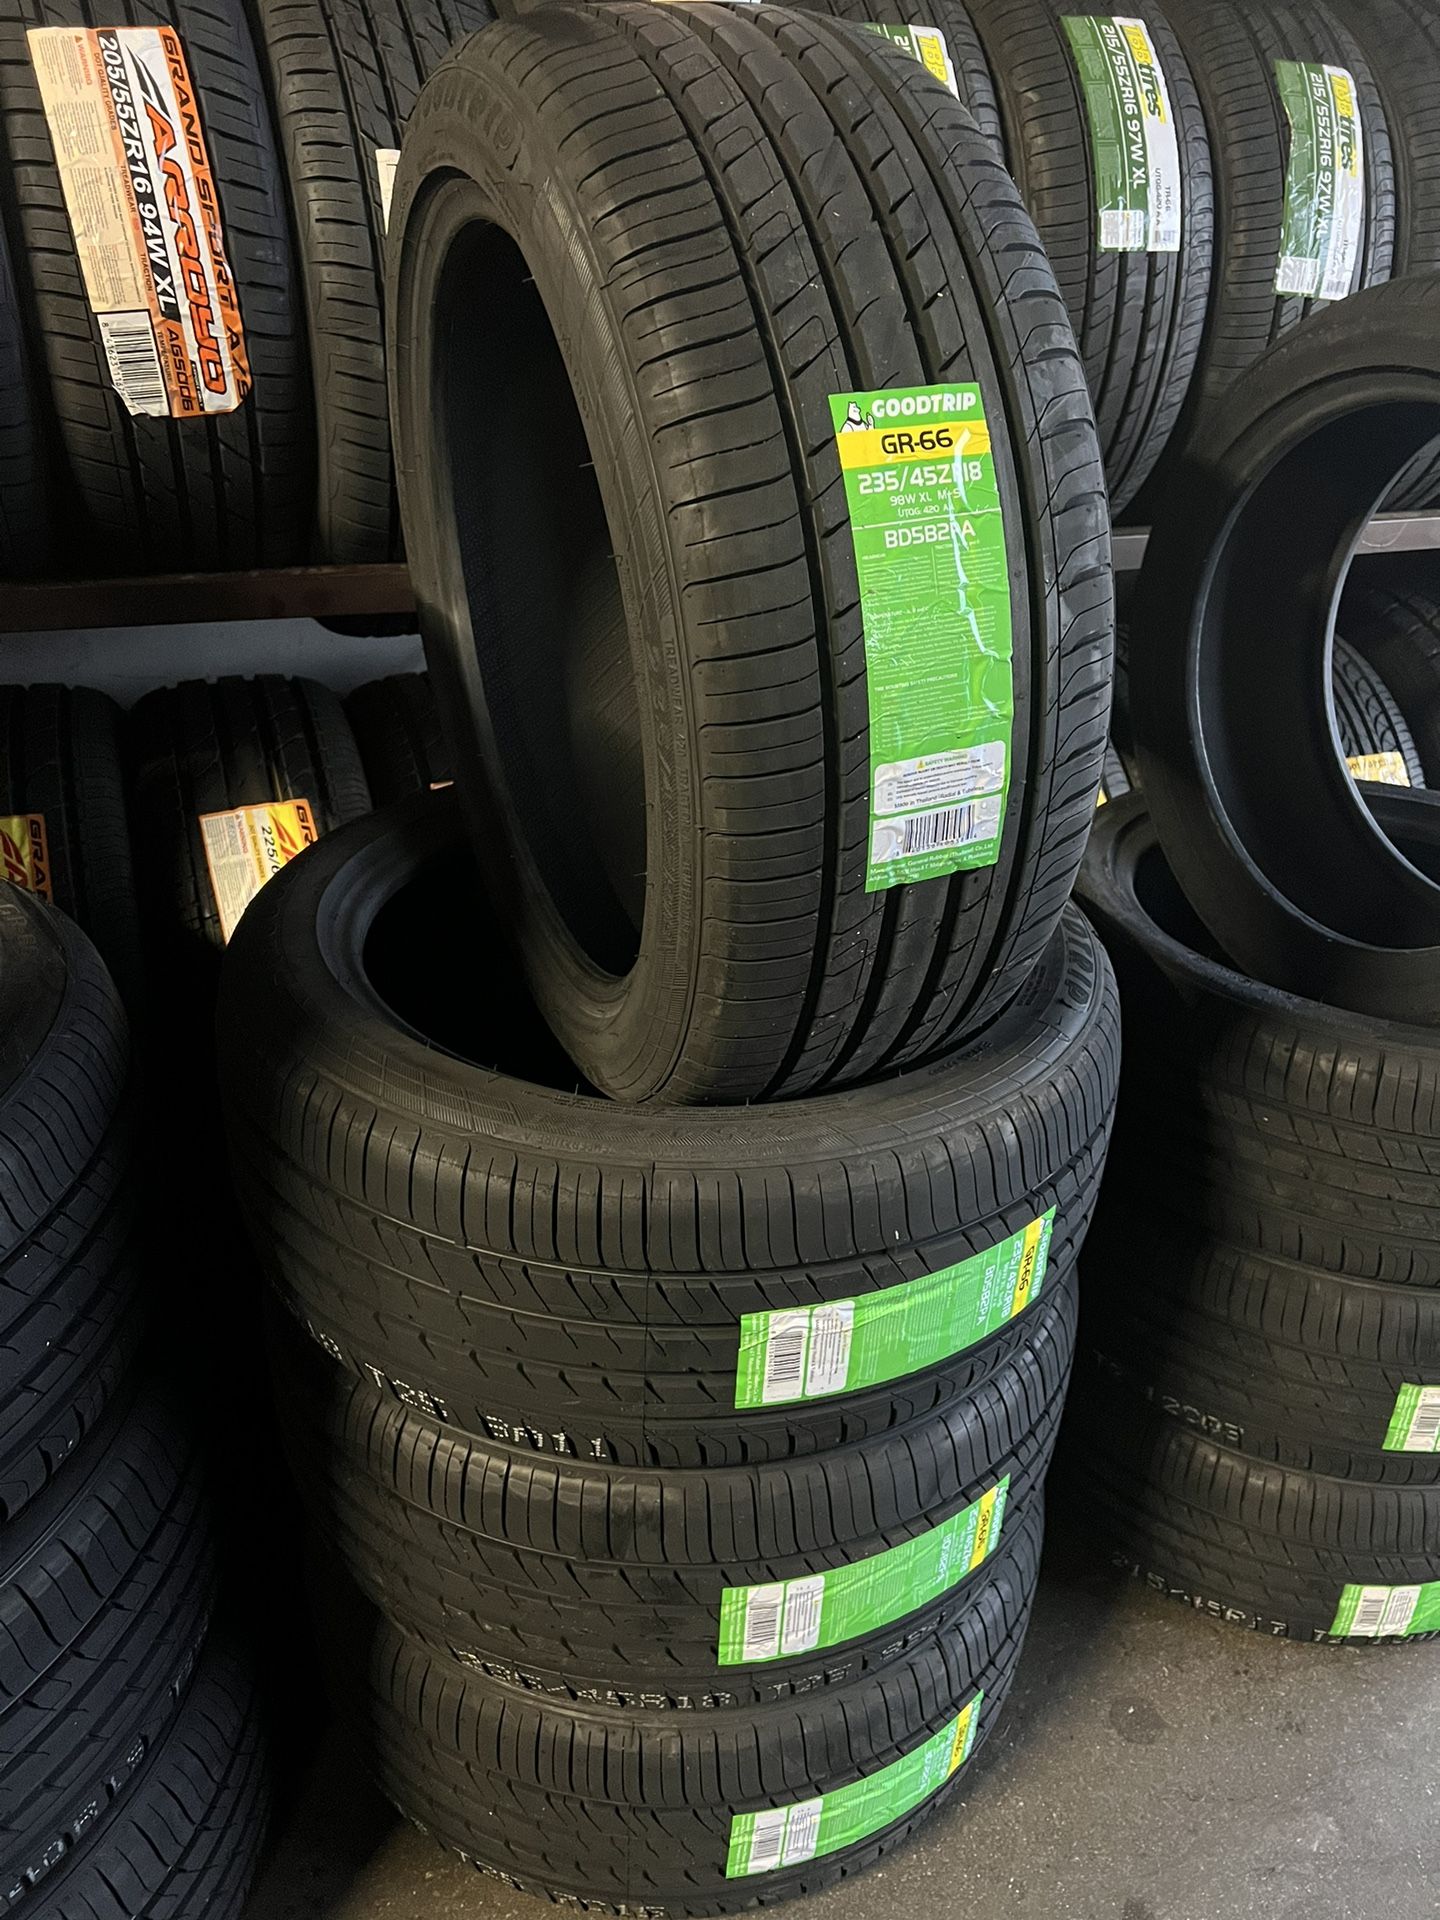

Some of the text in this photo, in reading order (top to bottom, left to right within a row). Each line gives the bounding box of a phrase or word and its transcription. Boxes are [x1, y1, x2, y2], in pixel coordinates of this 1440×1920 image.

[76, 43, 93, 86] WARNING
[93, 52, 117, 130] DOT QUALITY GRADES
[99, 35, 153, 192] 205/55ZR16
[1101, 24, 1144, 189] 215/55ZR16 97W XL
[1310, 73, 1331, 166] 215/55ZR16
[120, 165, 137, 213] TREADWEAR
[1318, 170, 1331, 214] 97W
[139, 203, 170, 266] 94W
[162, 33, 252, 401] GRAND SPORT A/S
[140, 252, 154, 291] TRACTION
[144, 102, 227, 393] ARROYO
[152, 270, 179, 312] XL
[157, 332, 172, 382] TEMPERATURE
[167, 326, 194, 411] AGS006
[871, 392, 976, 418] GOODTRIP
[882, 429, 953, 454] GR-66
[890, 494, 916, 506] 98W
[919, 489, 932, 502] XL
[898, 507, 920, 518] UTQG
[924, 505, 940, 515] 420
[1020, 1245, 1036, 1291] GR-66
